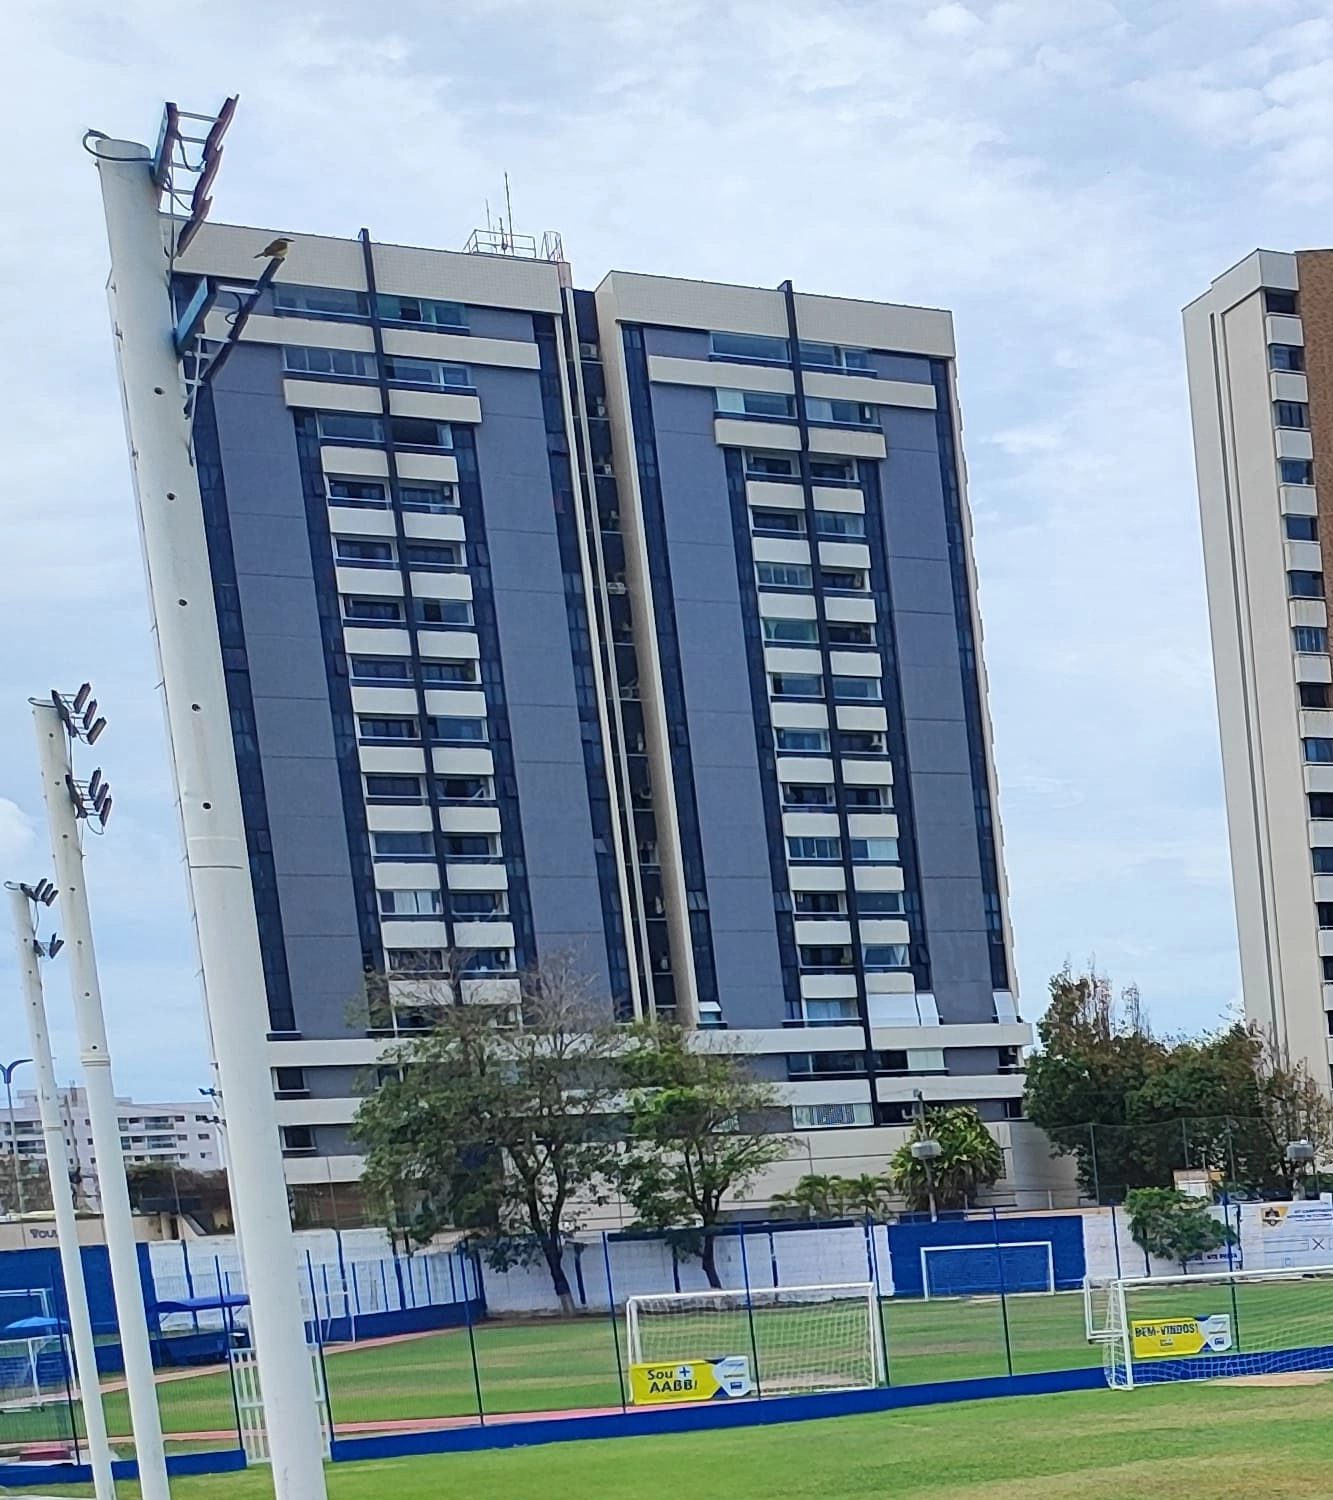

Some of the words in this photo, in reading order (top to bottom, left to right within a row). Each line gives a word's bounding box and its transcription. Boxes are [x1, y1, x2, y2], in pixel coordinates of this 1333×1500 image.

[1134, 1323, 1199, 1338] BEM-VINDOS!
[647, 1368, 674, 1381] Sou
[649, 1379, 698, 1394] AABB!
